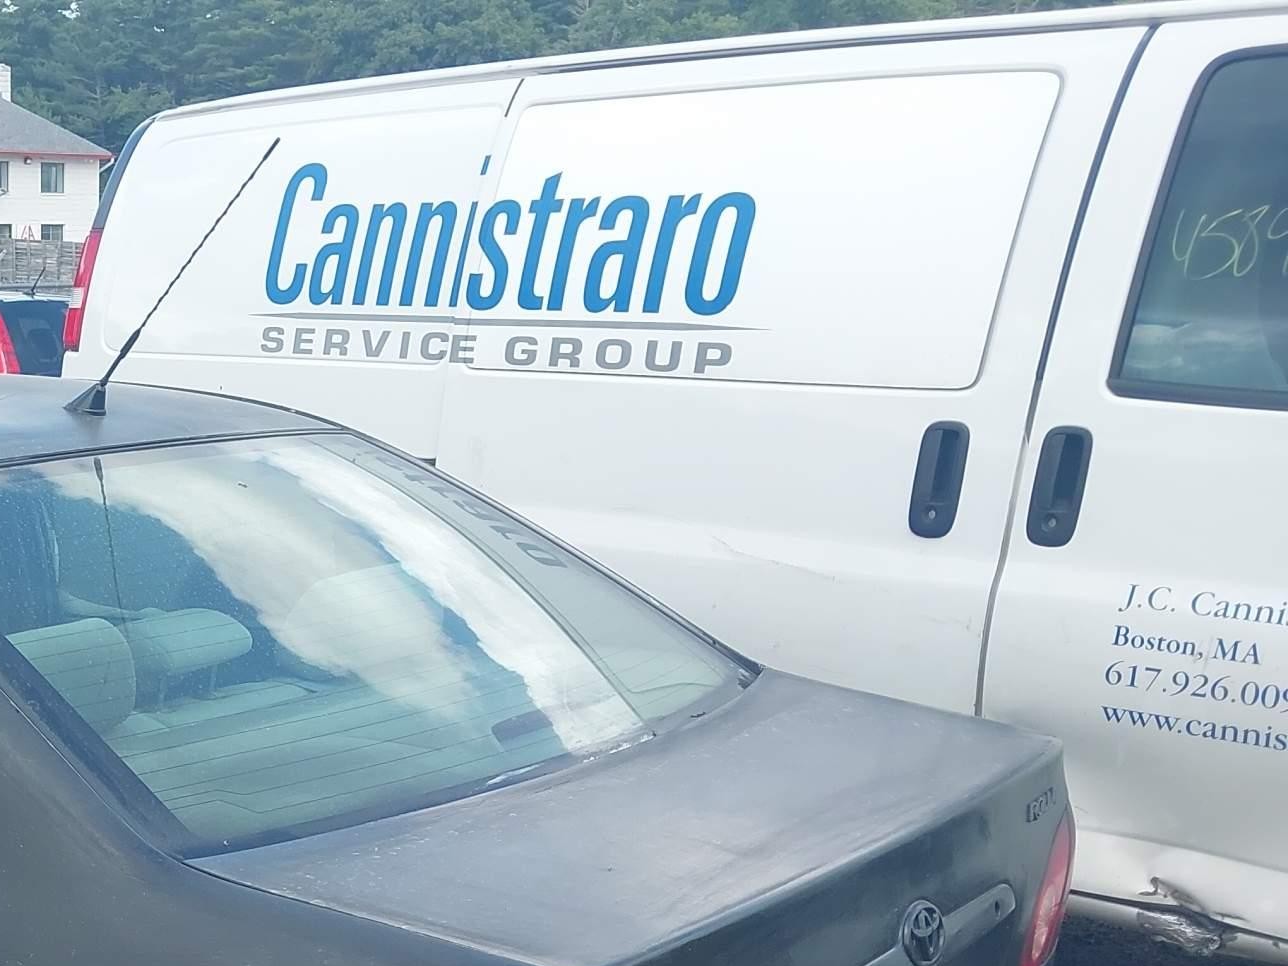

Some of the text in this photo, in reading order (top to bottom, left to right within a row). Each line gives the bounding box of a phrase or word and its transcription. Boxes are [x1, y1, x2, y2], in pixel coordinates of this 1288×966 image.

[264, 155, 757, 317] Cannistraro
[260, 326, 734, 374] SERVICE GROUP
[1118, 583, 1288, 627] J.C. Canni
[1111, 624, 1262, 666] Boston, MA
